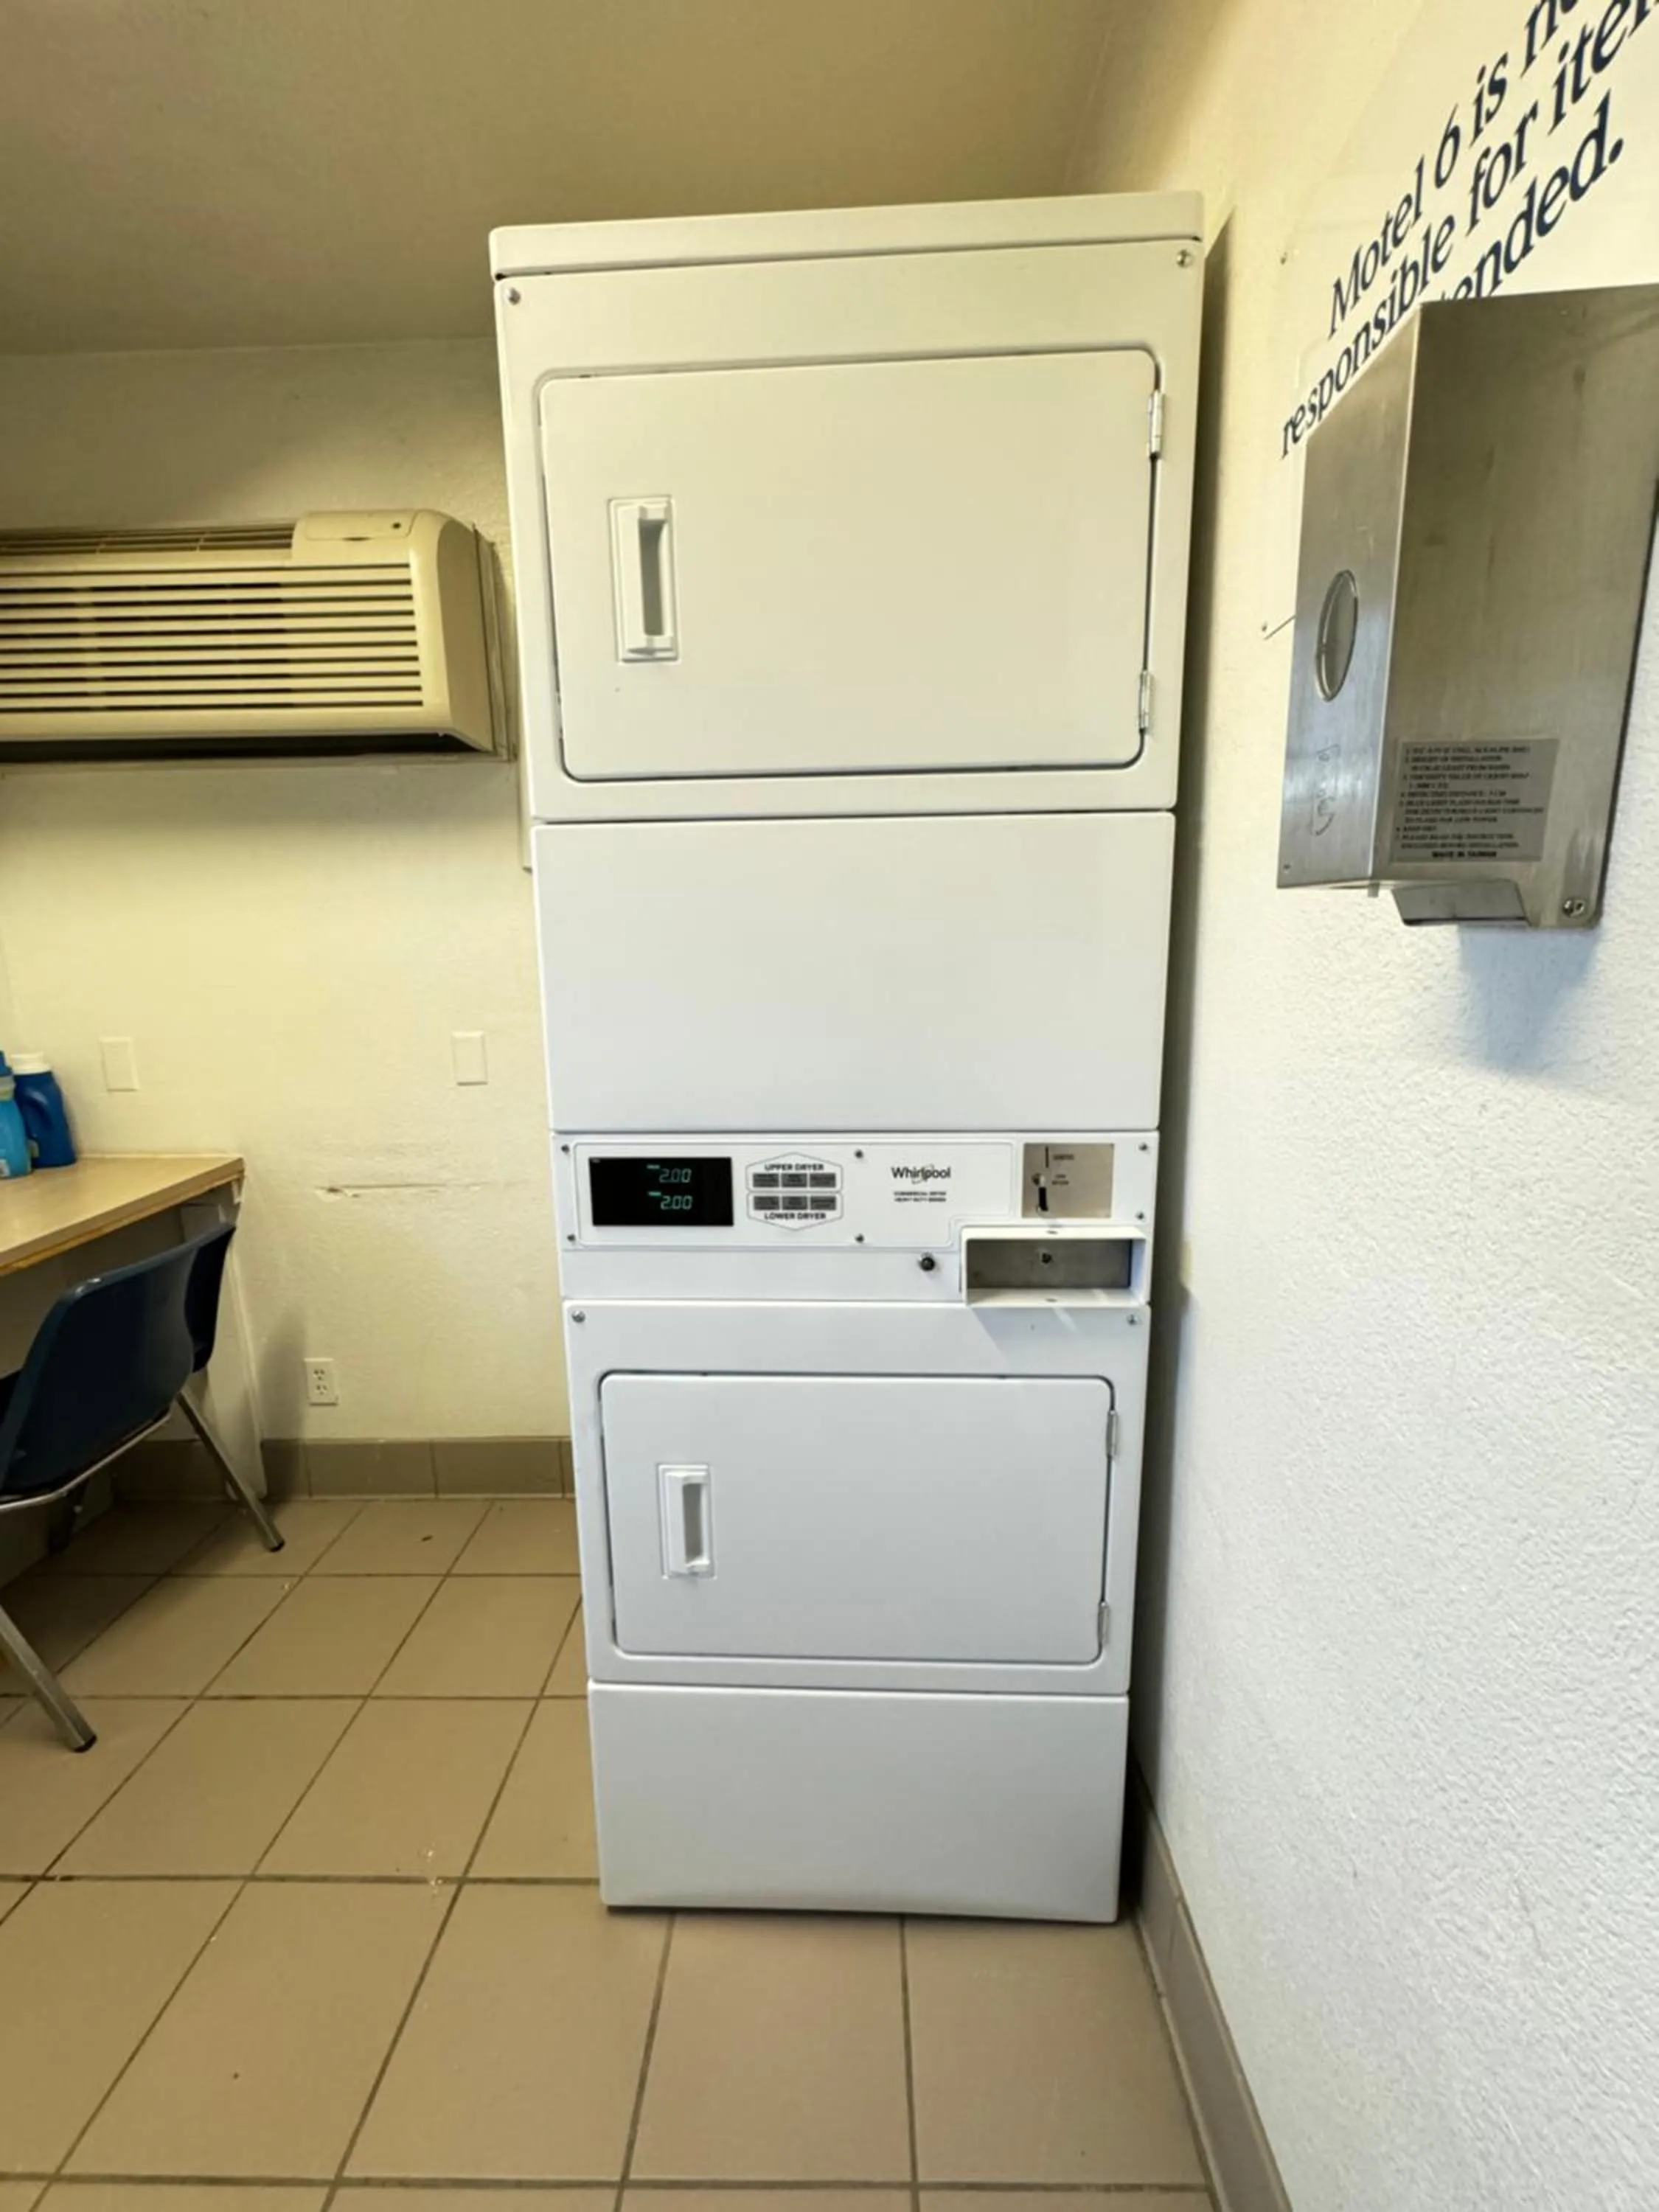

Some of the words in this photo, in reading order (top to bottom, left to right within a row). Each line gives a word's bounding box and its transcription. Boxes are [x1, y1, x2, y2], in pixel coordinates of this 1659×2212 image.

[1328, 154, 1425, 341] Motel
[1434, 102, 1461, 189] 6
[1469, 52, 1509, 149] is
[1281, 215, 1455, 459] responsible
[1465, 99, 1539, 238] for
[1547, 0, 1659, 137] ite
[795, 1163, 824, 1171] DRYER
[891, 1166, 951, 1183] Whirlpool
[764, 1212, 796, 1220] LOWER
